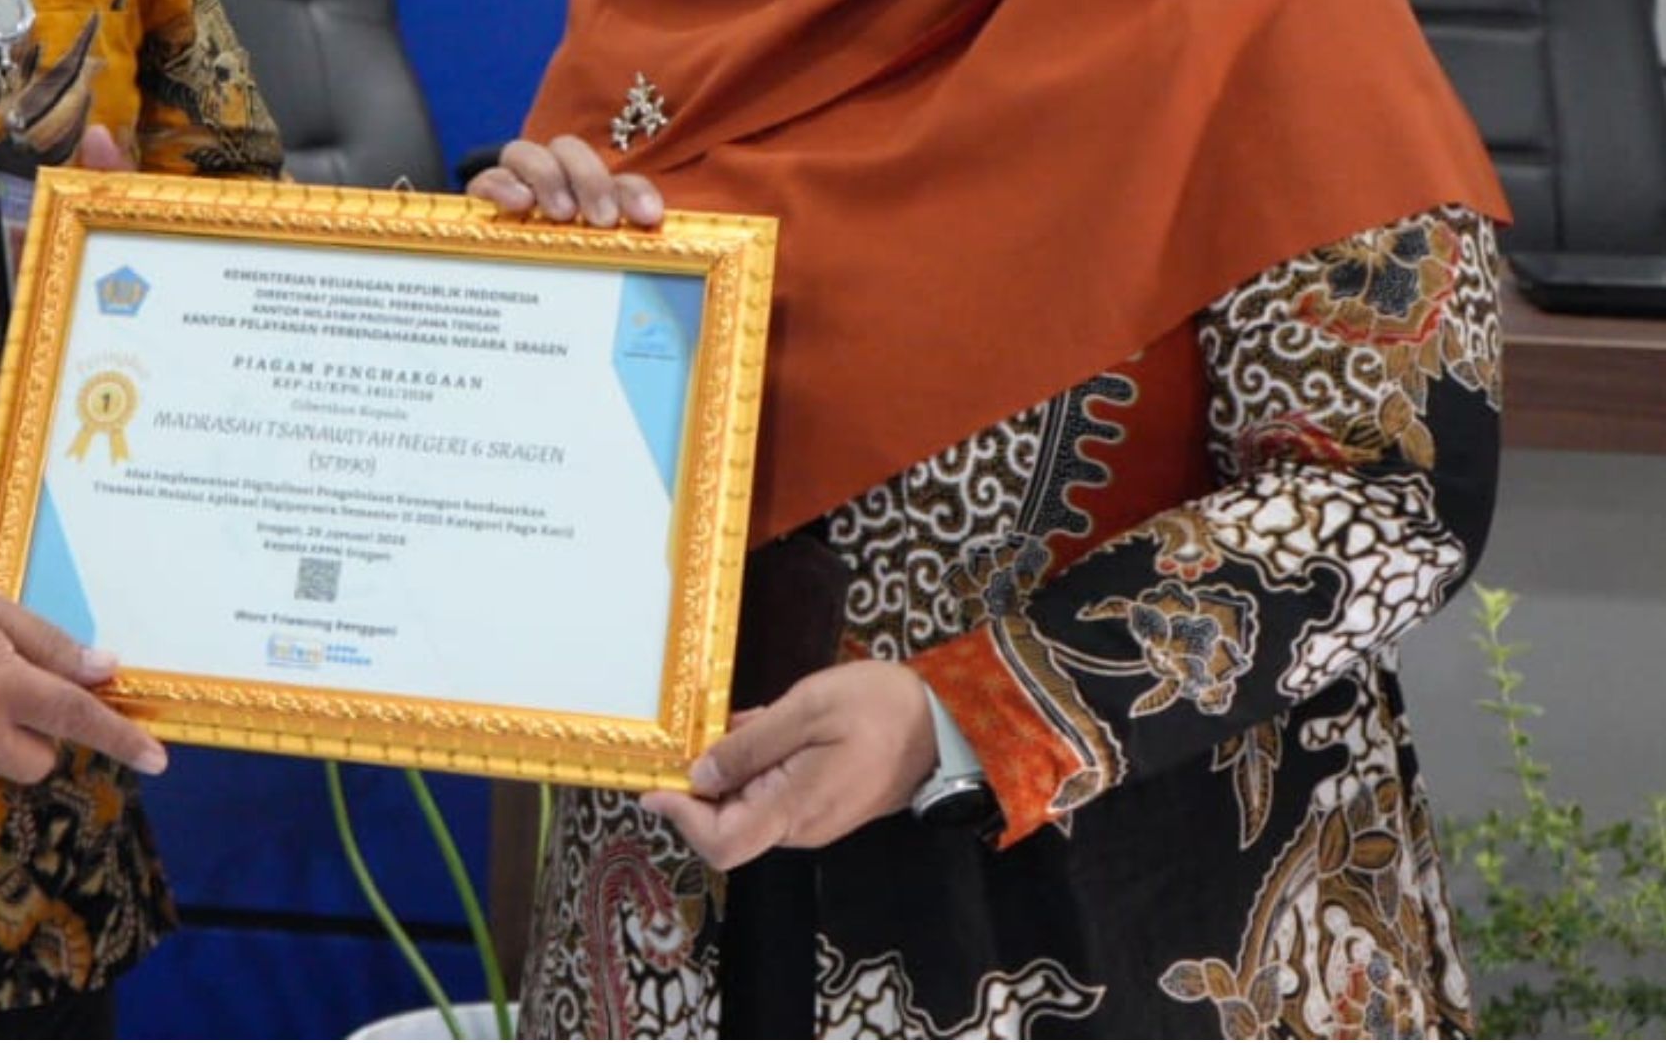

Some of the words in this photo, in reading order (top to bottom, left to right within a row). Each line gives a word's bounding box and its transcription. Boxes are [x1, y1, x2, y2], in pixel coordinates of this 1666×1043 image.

[223, 268, 316, 286] KEMENTERIAN
[319, 274, 395, 293] KEUANGAN
[397, 281, 461, 299] REPUBLIK
[464, 287, 539, 305] INDONESIA
[251, 304, 300, 317] KANTOR
[303, 308, 357, 322] WILAYAH
[415, 316, 448, 330] JAWA
[451, 319, 501, 334] TENGAH
[254, 288, 327, 303] DIREKTORAT
[327, 294, 385, 310] JENDERAL
[388, 299, 502, 318] PERBENDAHARAAN
[182, 313, 236, 328] KANTOR
[239, 317, 319, 336] PELAYANAN
[321, 324, 448, 347] PERBENDAHARAAN
[451, 334, 507, 351] NEGARA
[514, 340, 569, 357] SRAGEN
[232, 355, 314, 374] PIAGAM
[323, 362, 483, 389] PENGHARGAAN
[102, 392, 111, 413] 1
[152, 410, 262, 437] MADRASAH
[397, 430, 468, 456] NEGERI
[470, 438, 484, 457] 6
[486, 439, 566, 466] SRAGEN
[445, 516, 503, 533] Kategori
